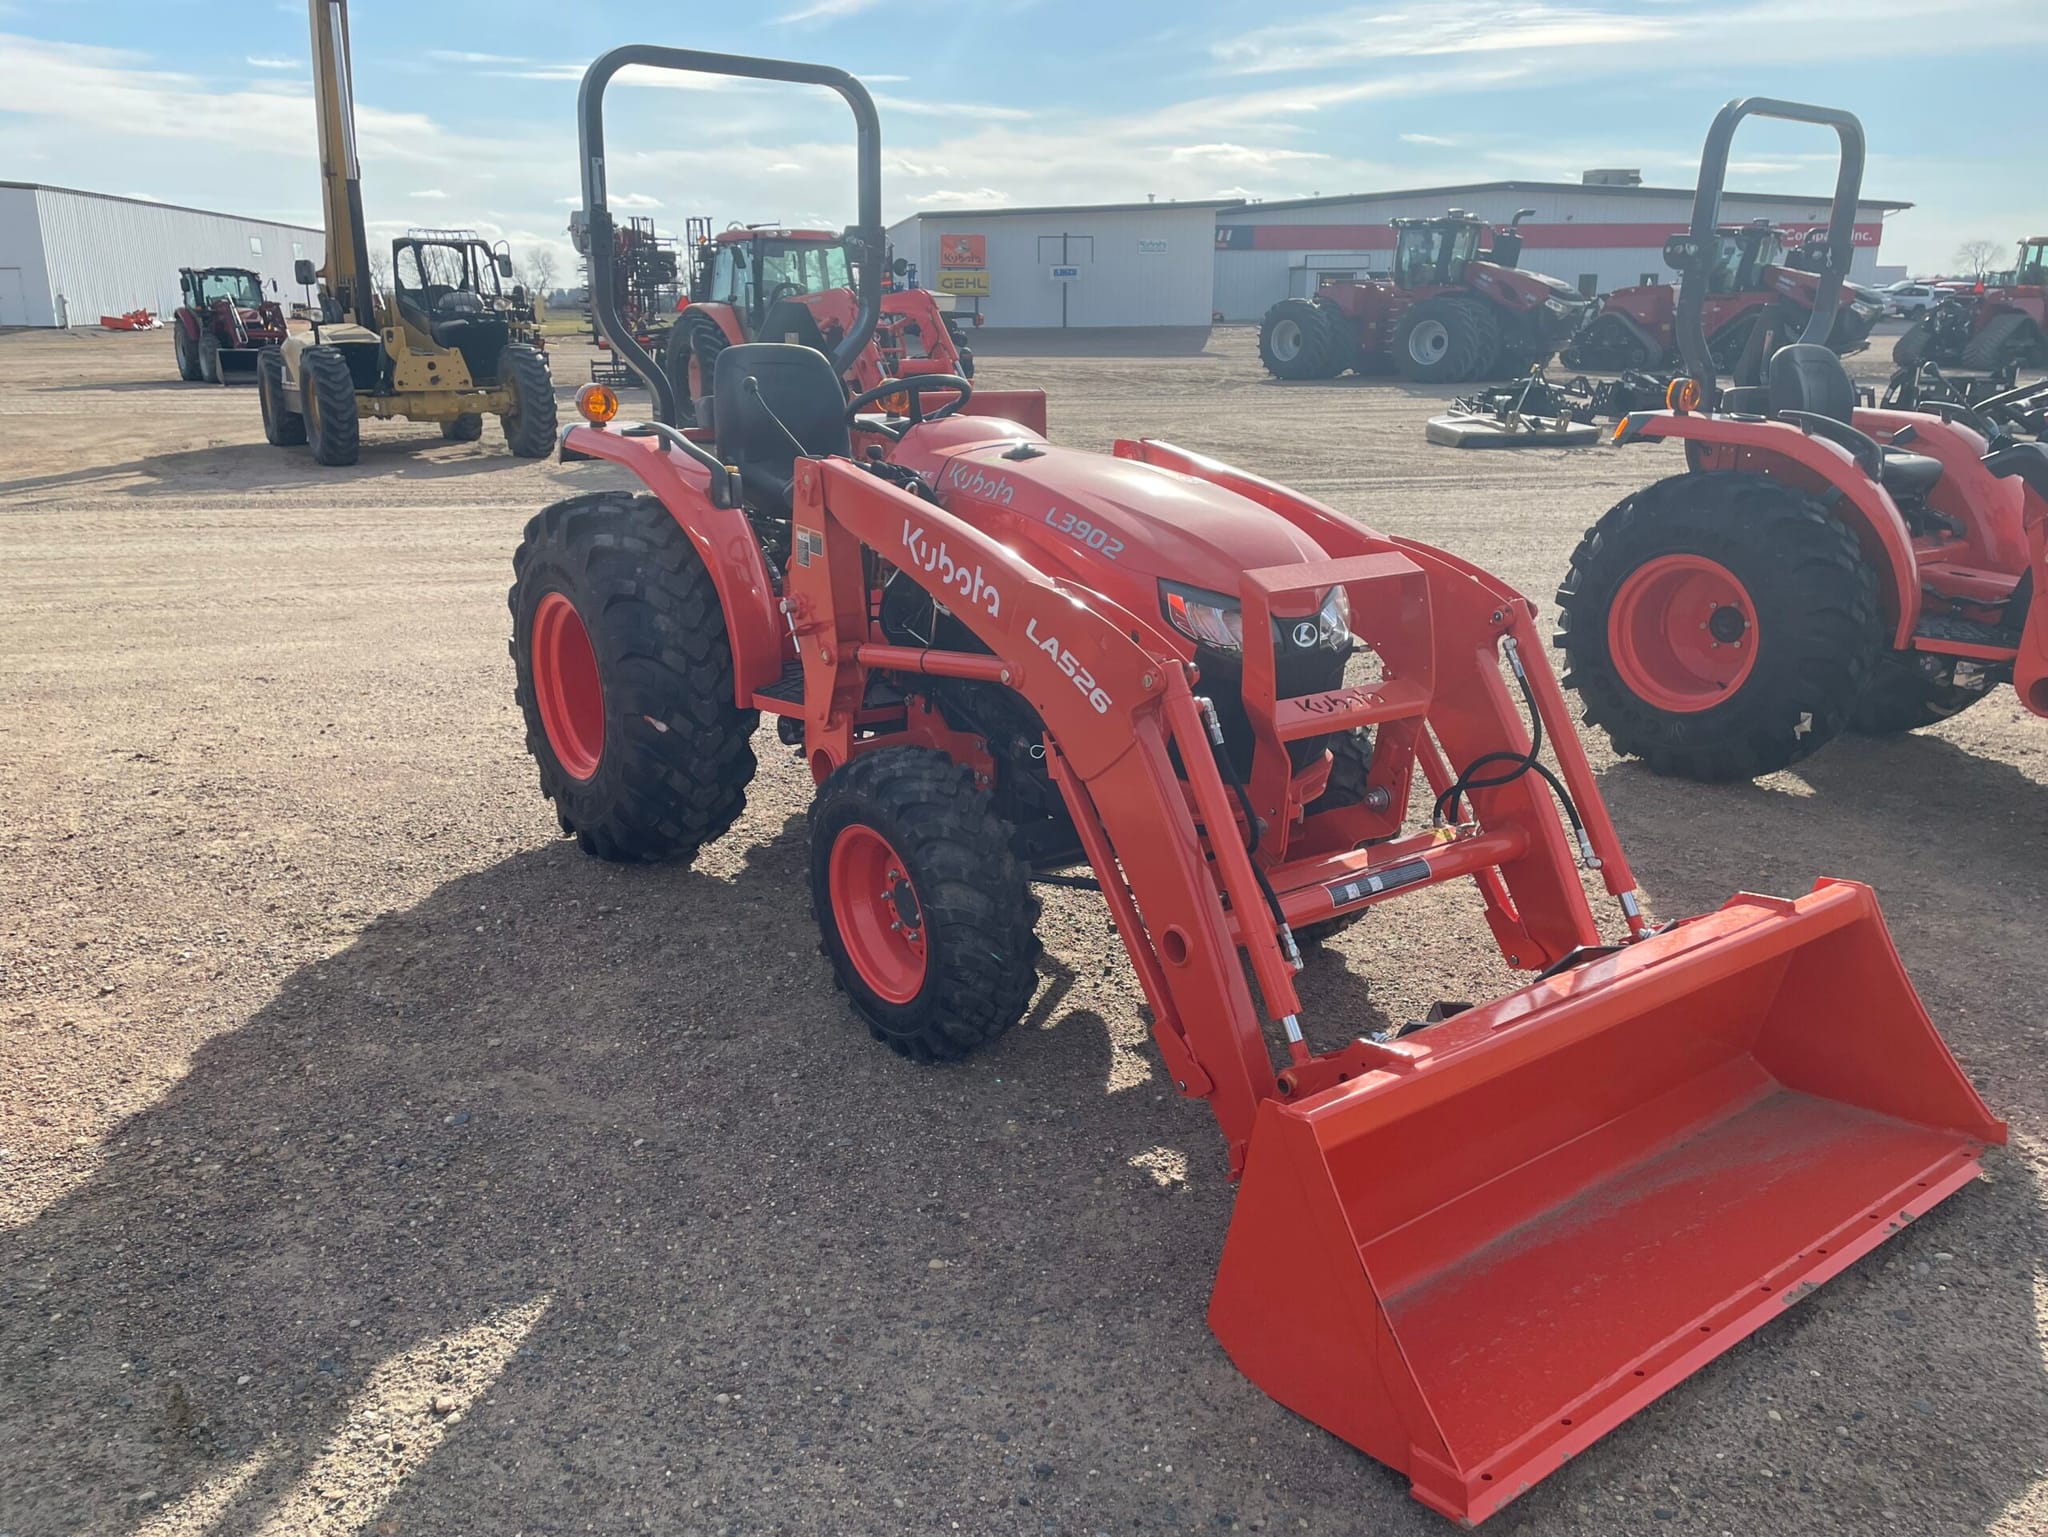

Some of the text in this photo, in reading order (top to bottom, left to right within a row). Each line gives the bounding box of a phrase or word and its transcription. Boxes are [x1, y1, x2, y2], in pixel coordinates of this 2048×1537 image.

[1851, 229, 1873, 241] Inc.
[942, 277, 987, 289] GEHL
[949, 462, 1015, 505] Kubota
[1045, 507, 1125, 560] L3902
[903, 518, 1000, 618] Kubota
[1025, 617, 1113, 714] LA526
